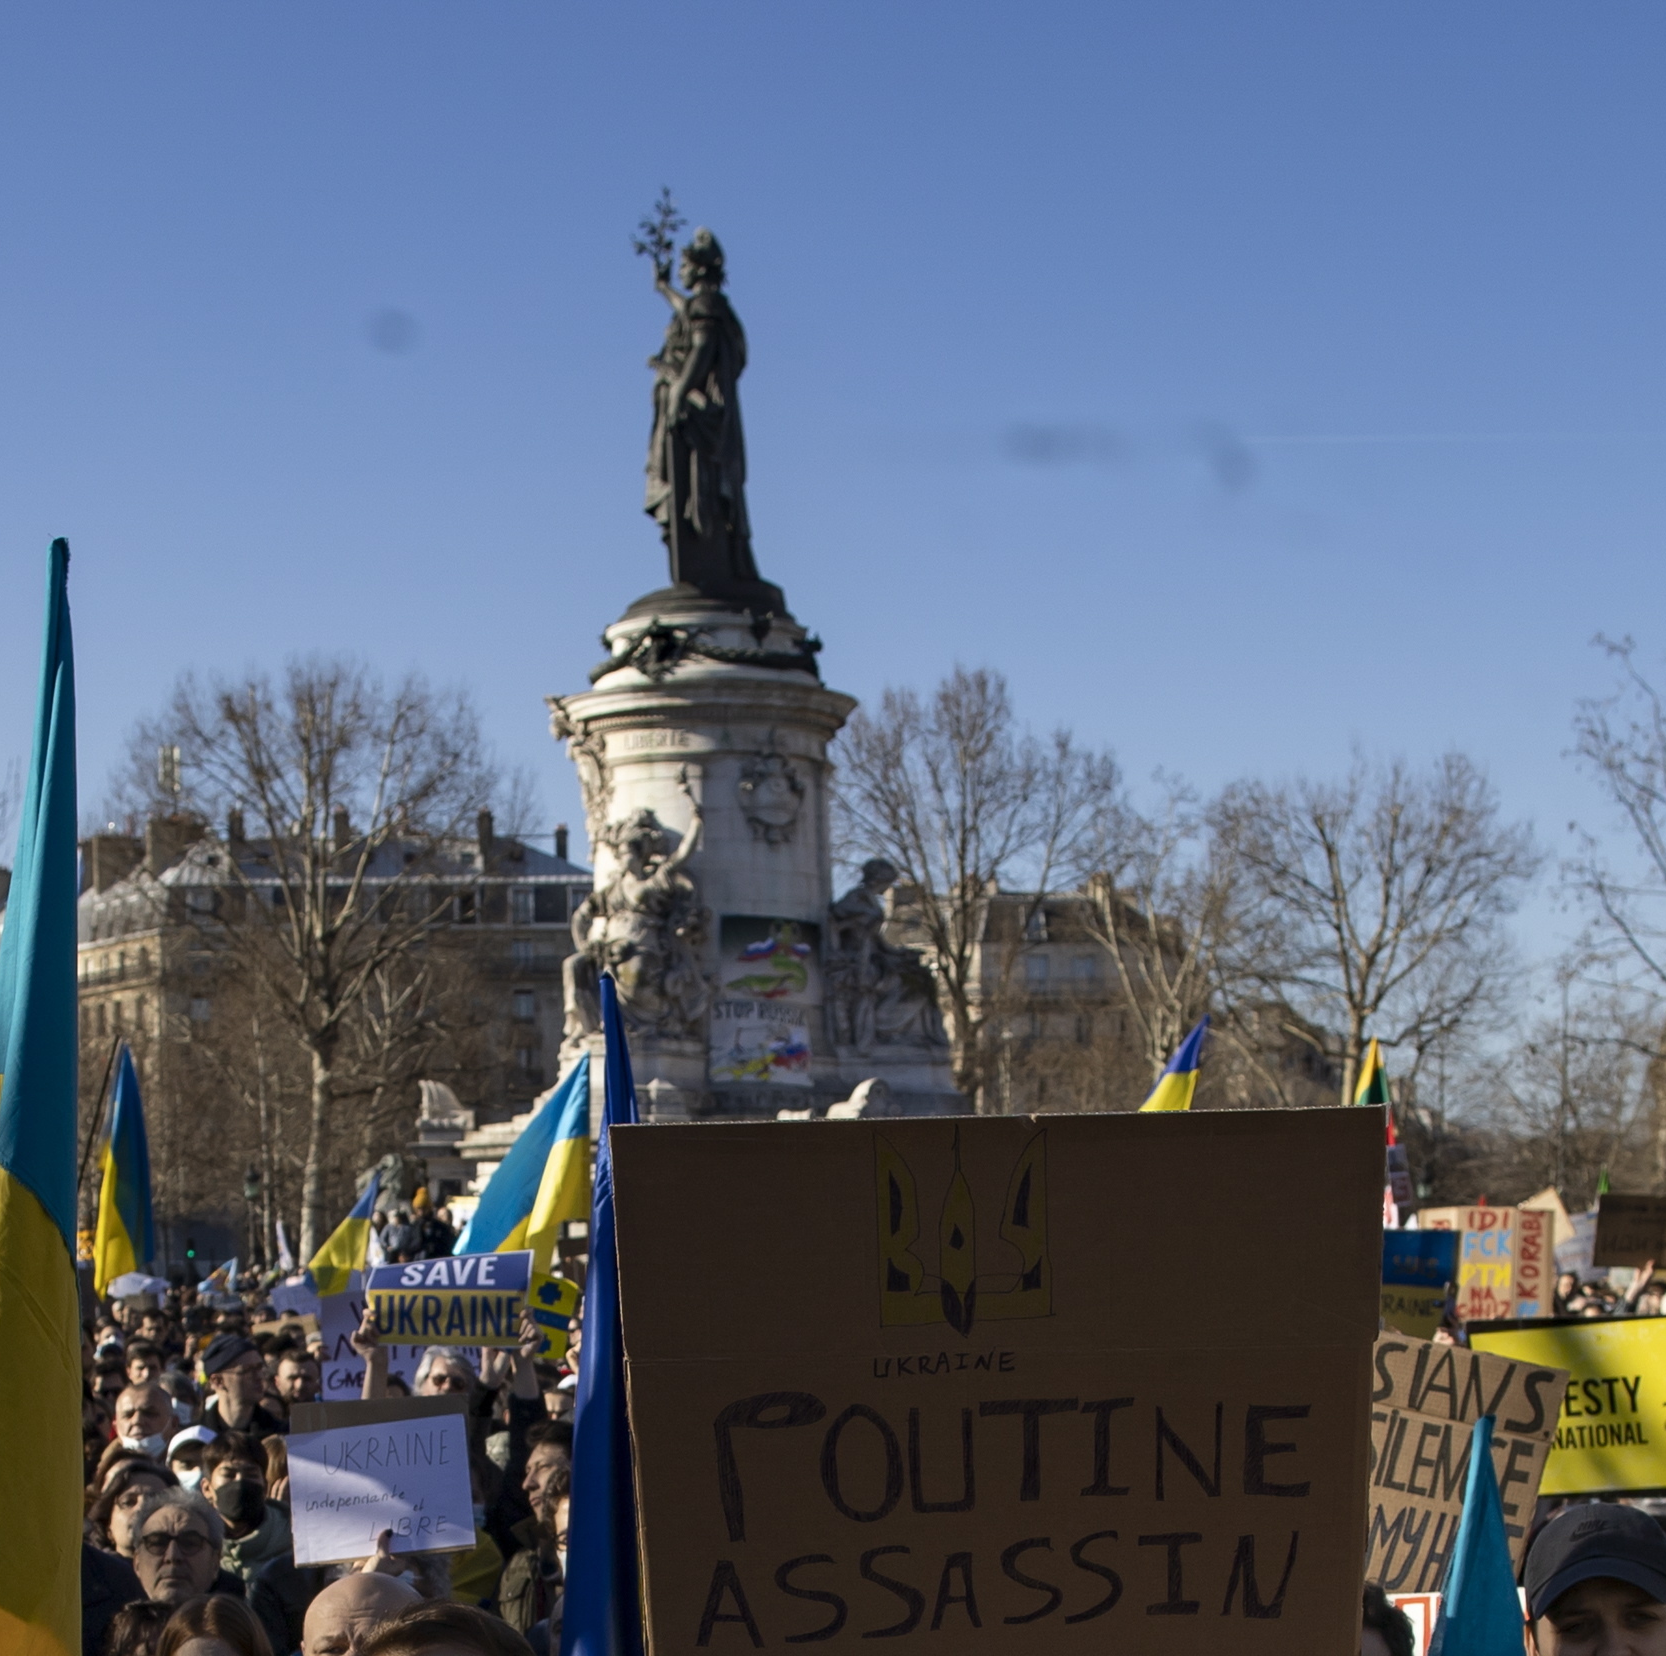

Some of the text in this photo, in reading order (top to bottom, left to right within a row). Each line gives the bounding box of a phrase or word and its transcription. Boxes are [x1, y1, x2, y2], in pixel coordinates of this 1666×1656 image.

[1467, 1209, 1509, 1231] IDI
[1463, 1230, 1513, 1259] FCK
[399, 1255, 499, 1288] SAVE
[1459, 1262, 1512, 1288] PTN
[1470, 1286, 1496, 1301] NA
[374, 1294, 523, 1338] UKRAINE
[873, 1348, 1017, 1379] UKRAINE
[1373, 1340, 1557, 1440] SIANS.
[1562, 1375, 1642, 1418] ESTY
[1551, 1420, 1649, 1451] NATIONAL
[323, 1429, 451, 1475] UKRAINE
[713, 1391, 1312, 1542] POUTINE
[412, 1498, 425, 1513] et
[696, 1530, 1299, 1648] ASSASSIN
